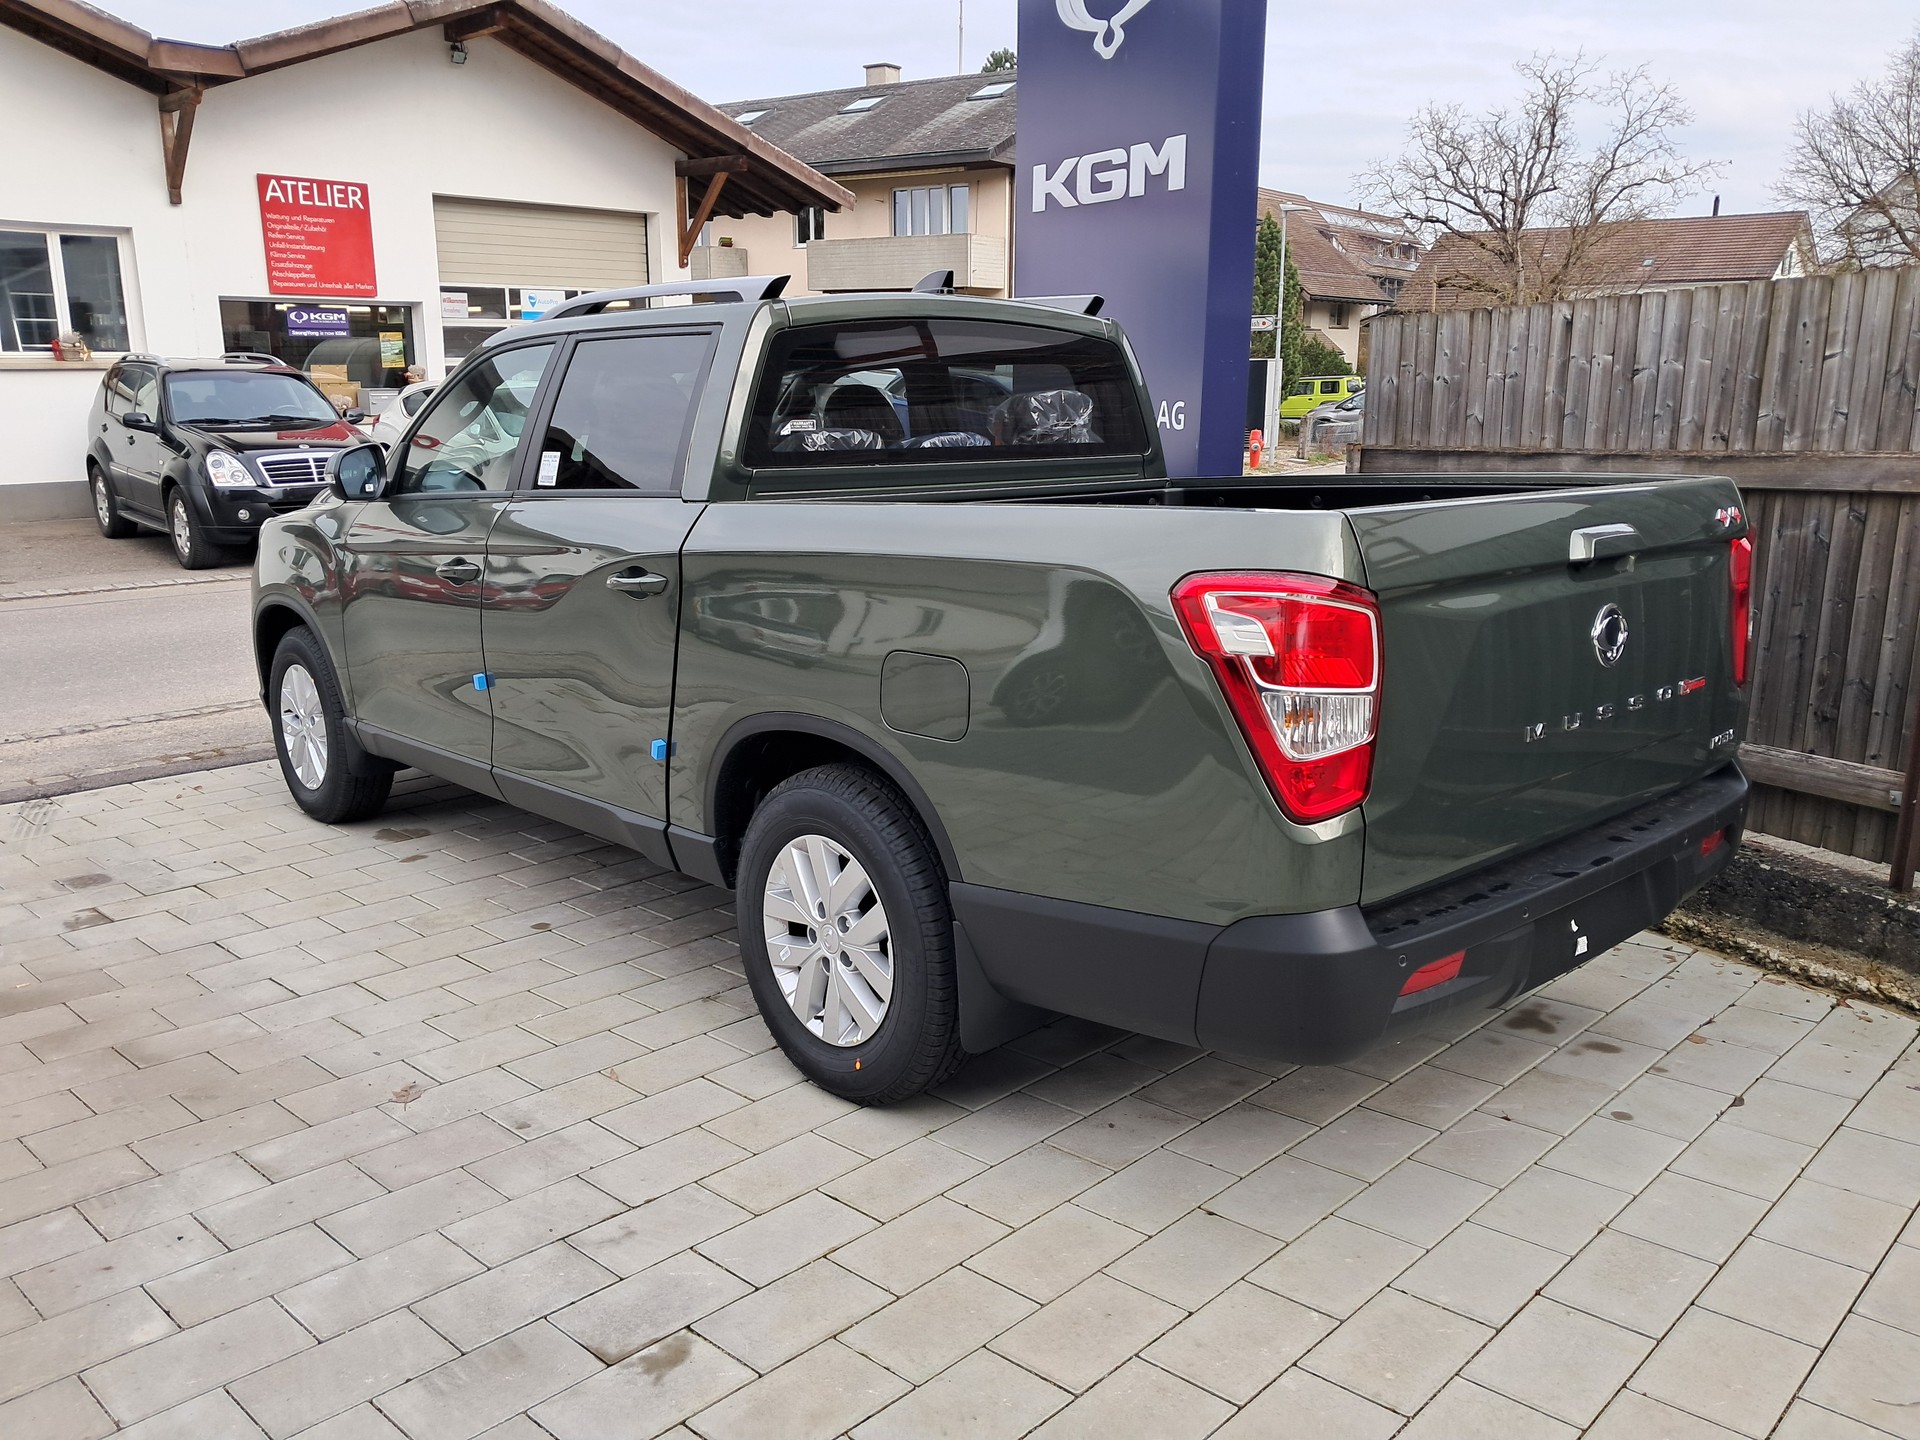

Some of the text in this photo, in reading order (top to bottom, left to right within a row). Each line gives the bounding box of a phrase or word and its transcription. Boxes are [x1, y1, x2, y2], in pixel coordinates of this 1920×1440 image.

[1032, 134, 1187, 212] KGM
[265, 179, 364, 209] ATELIER
[265, 212, 290, 222] Wartung
[303, 215, 335, 223] Reparaturen
[273, 280, 306, 288] Reparaturen
[1157, 400, 1185, 430] AG
[1525, 685, 1674, 743] MUSSO
